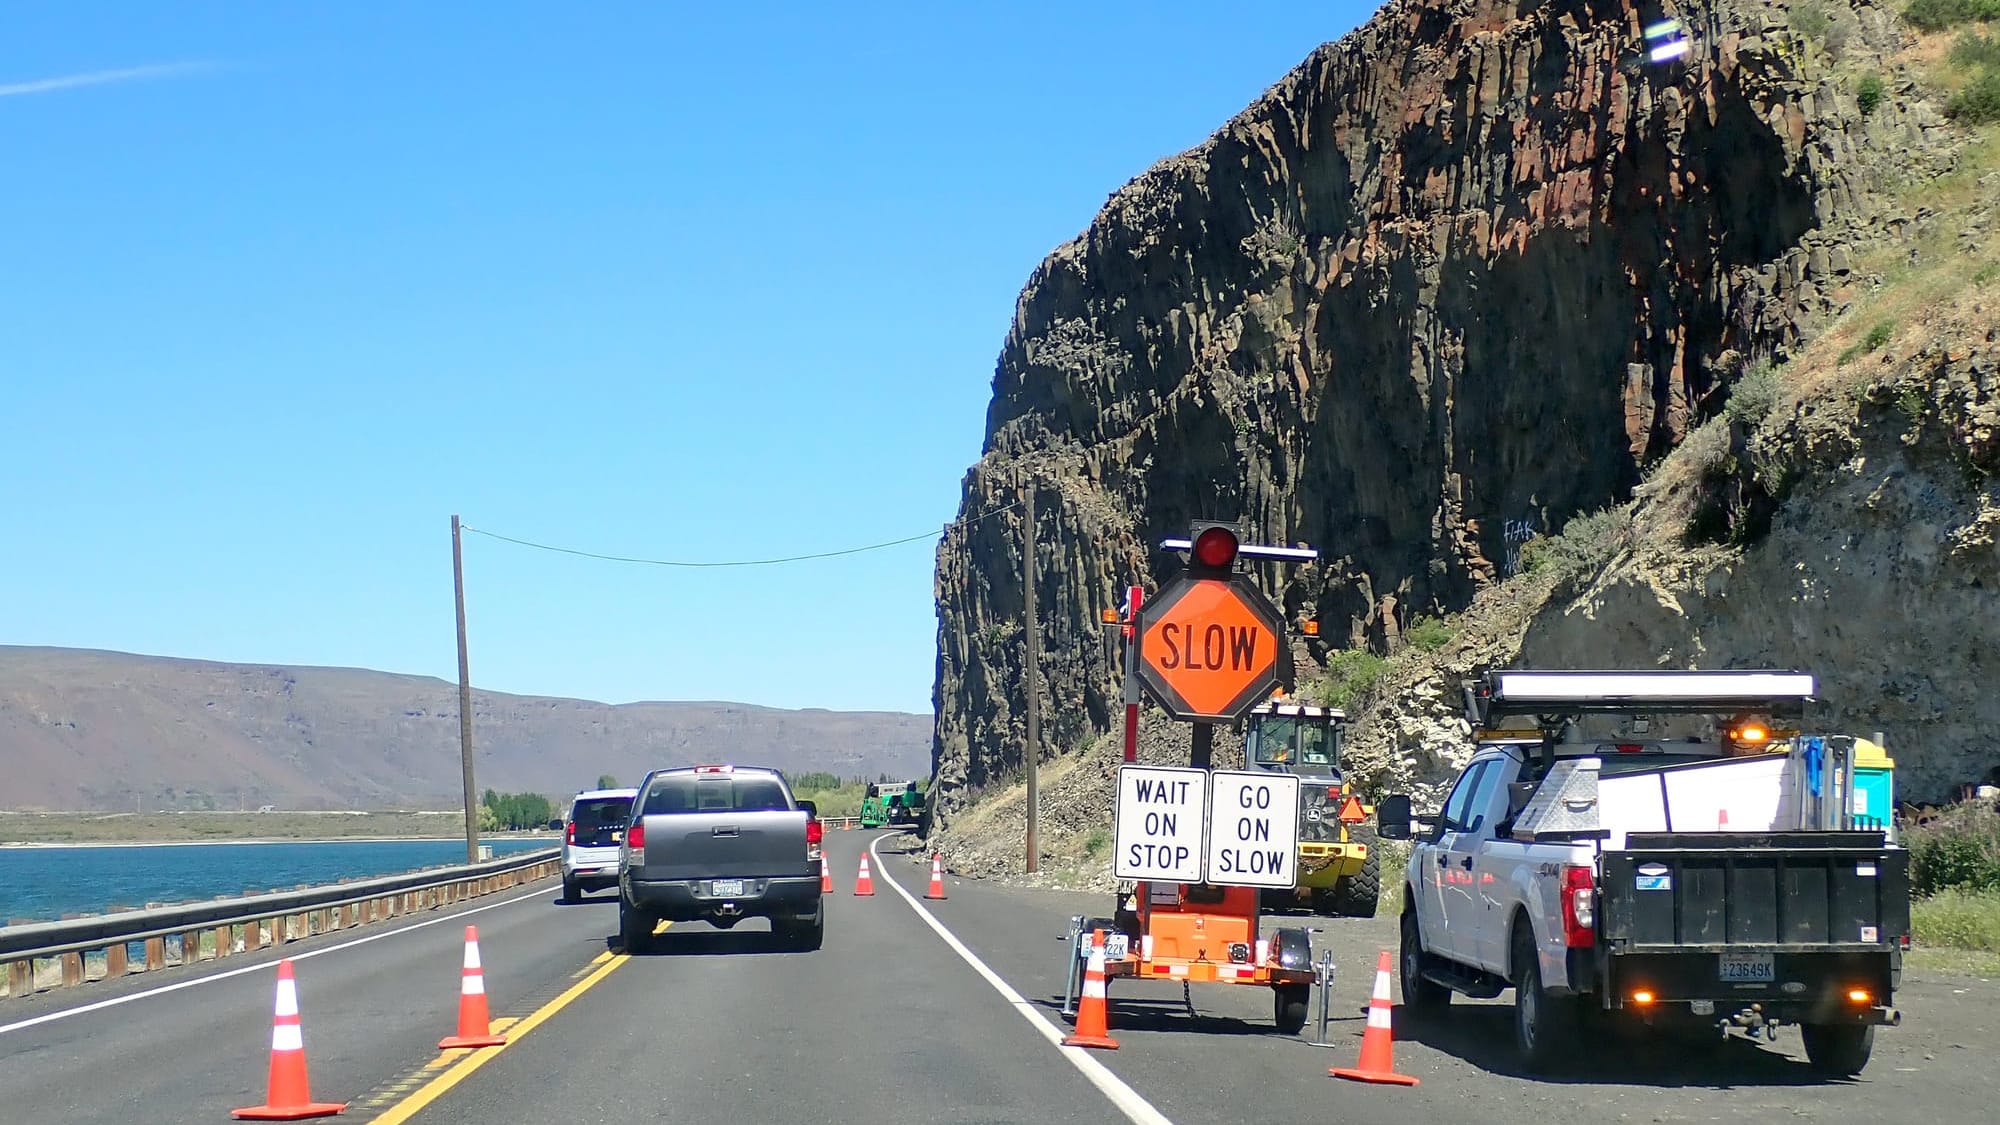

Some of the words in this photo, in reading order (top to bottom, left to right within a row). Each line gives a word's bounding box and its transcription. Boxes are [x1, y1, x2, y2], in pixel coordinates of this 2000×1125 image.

[1160, 622, 1257, 671] SLOW
[1136, 779, 1190, 805] WAIT
[1239, 785, 1270, 809] GO
[1145, 812, 1176, 837] ON
[1238, 817, 1269, 842] ON
[1128, 844, 1189, 869] STOP
[1219, 849, 1284, 875] SLOW
